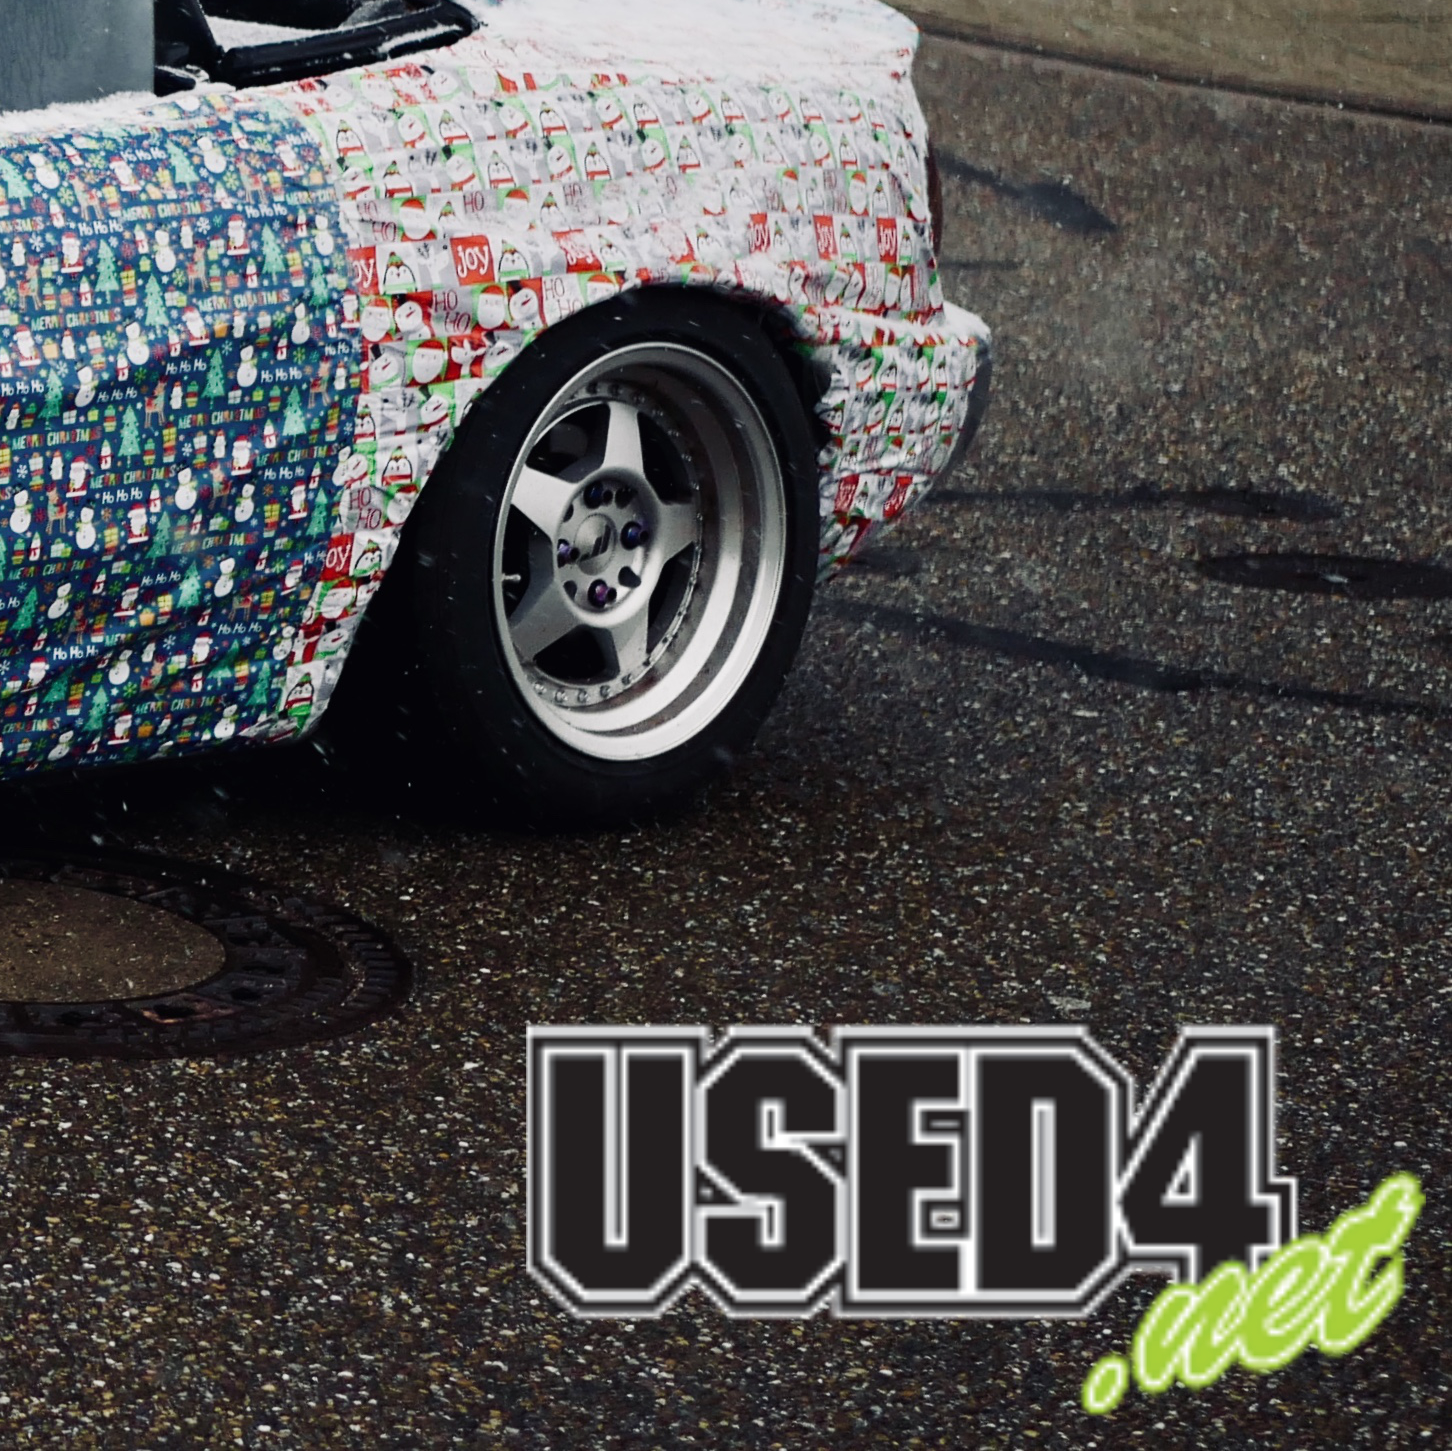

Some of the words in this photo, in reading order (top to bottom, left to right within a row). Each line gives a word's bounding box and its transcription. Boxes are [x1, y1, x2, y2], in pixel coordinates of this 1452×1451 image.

[246, 205, 259, 218] Ho
[261, 204, 273, 216] Ho
[275, 202, 287, 215] Ho
[464, 191, 484, 213] HO
[79, 222, 93, 236] Ho
[96, 220, 108, 234] Ho
[110, 219, 124, 232] Ho
[817, 224, 834, 257] joy
[878, 226, 896, 255] joy
[457, 246, 489, 278] joy
[544, 278, 565, 298] HO
[199, 295, 230, 310] MERRY
[234, 289, 290, 308] CHRISTMAS
[434, 290, 457, 312] HO
[31, 316, 63, 331] MERRY
[67, 308, 121, 327] CHRISTMAS
[445, 313, 470, 332] HO
[166, 363, 177, 374] Ho
[180, 361, 191, 373] Ho
[194, 359, 206, 371] Ho
[261, 370, 273, 382] Ho
[275, 368, 287, 380] Ho
[290, 367, 302, 379] Ho
[2, 383, 14, 396] Ho
[17, 382, 29, 394] Ho
[32, 380, 44, 392] Ho
[98, 391, 109, 402] Ho
[112, 389, 123, 400] Ho
[125, 387, 137, 398] Ho
[90, 473, 121, 489] MERRY
[123, 466, 177, 484] CHRISTMAS
[264, 468, 277, 480] Ho
[279, 467, 292, 479] Ho
[295, 466, 305, 477] Ho
[102, 492, 115, 504] Ho
[116, 490, 129, 502] Ho
[131, 487, 143, 500] Ho
[350, 487, 371, 510] HO
[358, 508, 382, 529] HO
[142, 576, 153, 586] Ho
[155, 574, 167, 584] Ho
[170, 572, 181, 582] Ho
[8, 598, 20, 609] Ho
[218, 625, 230, 635] Ho
[234, 624, 246, 633] Ho
[249, 622, 262, 632] Ho
[53, 647, 67, 660] Ho
[70, 646, 83, 658] Ho
